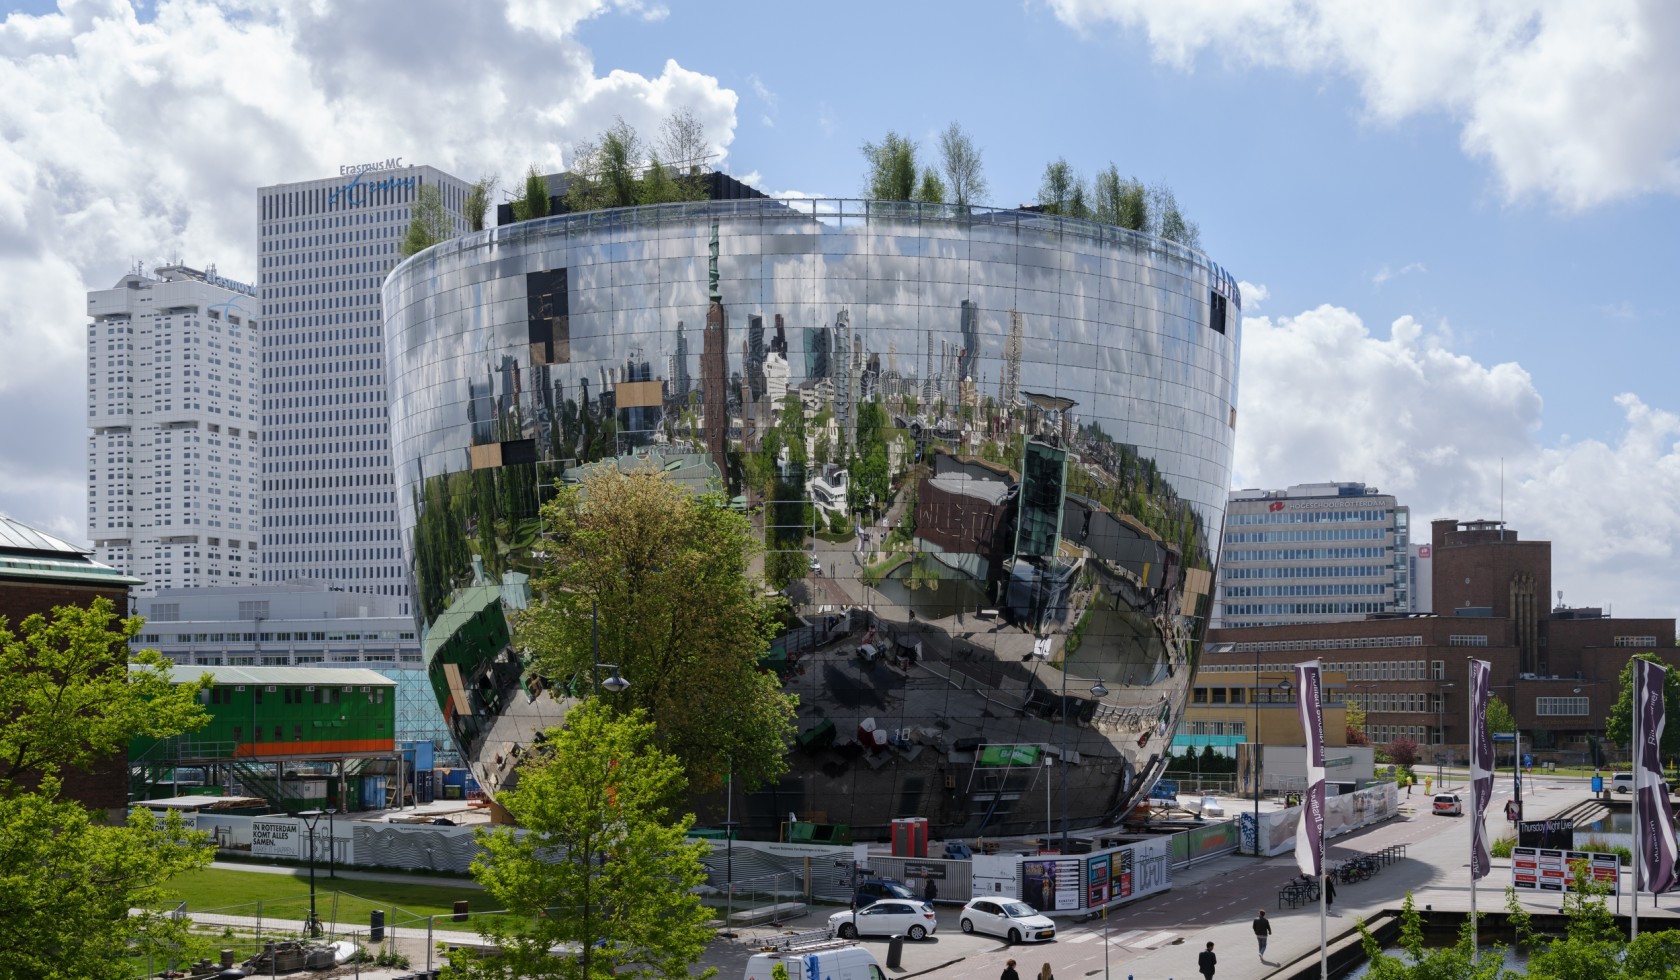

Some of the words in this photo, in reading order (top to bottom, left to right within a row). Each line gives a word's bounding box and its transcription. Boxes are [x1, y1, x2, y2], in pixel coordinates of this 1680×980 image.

[340, 161, 384, 175] Erasmus
[385, 157, 403, 170] MC
[1289, 502, 1339, 510] HOGESCHOOL
[1340, 500, 1386, 508] ROTTERDAM
[253, 823, 260, 831] IN
[261, 824, 297, 833] ROTTERDAM
[1521, 822, 1546, 834] Thursday
[1546, 820, 1560, 832] Night
[1561, 820, 1573, 829] Live!
[272, 832, 289, 840] ALLES
[253, 838, 276, 846] SAMEN.
[1650, 820, 1659, 863] Museum
